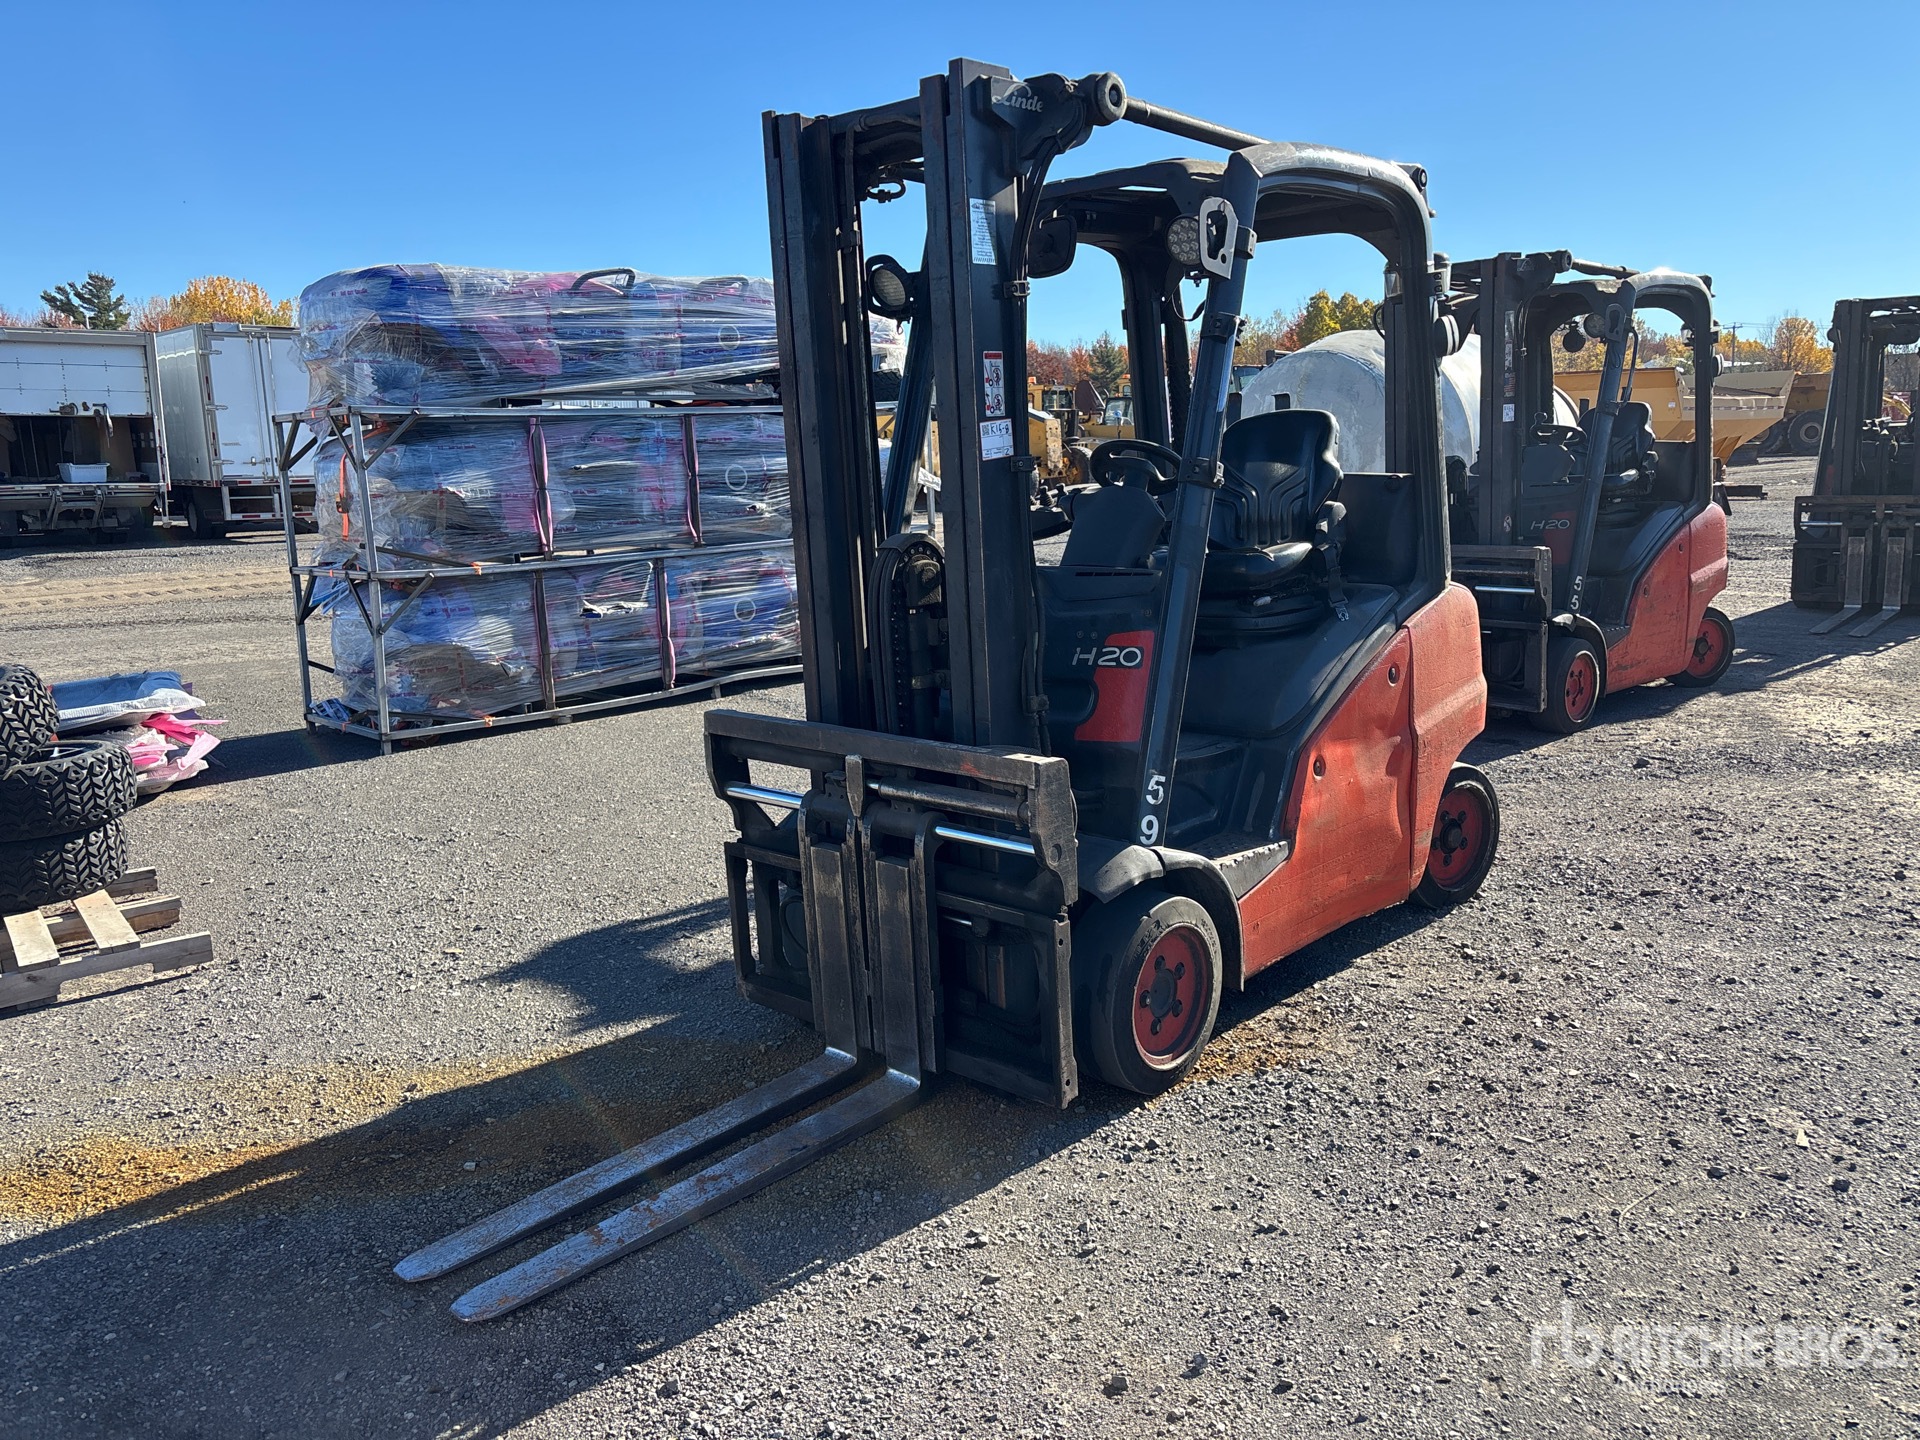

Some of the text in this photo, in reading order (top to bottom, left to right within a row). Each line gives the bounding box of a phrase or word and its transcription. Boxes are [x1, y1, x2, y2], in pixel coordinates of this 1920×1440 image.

[991, 82, 1043, 113] Linde
[1529, 519, 1570, 530] H20
[1072, 646, 1142, 667] H20
